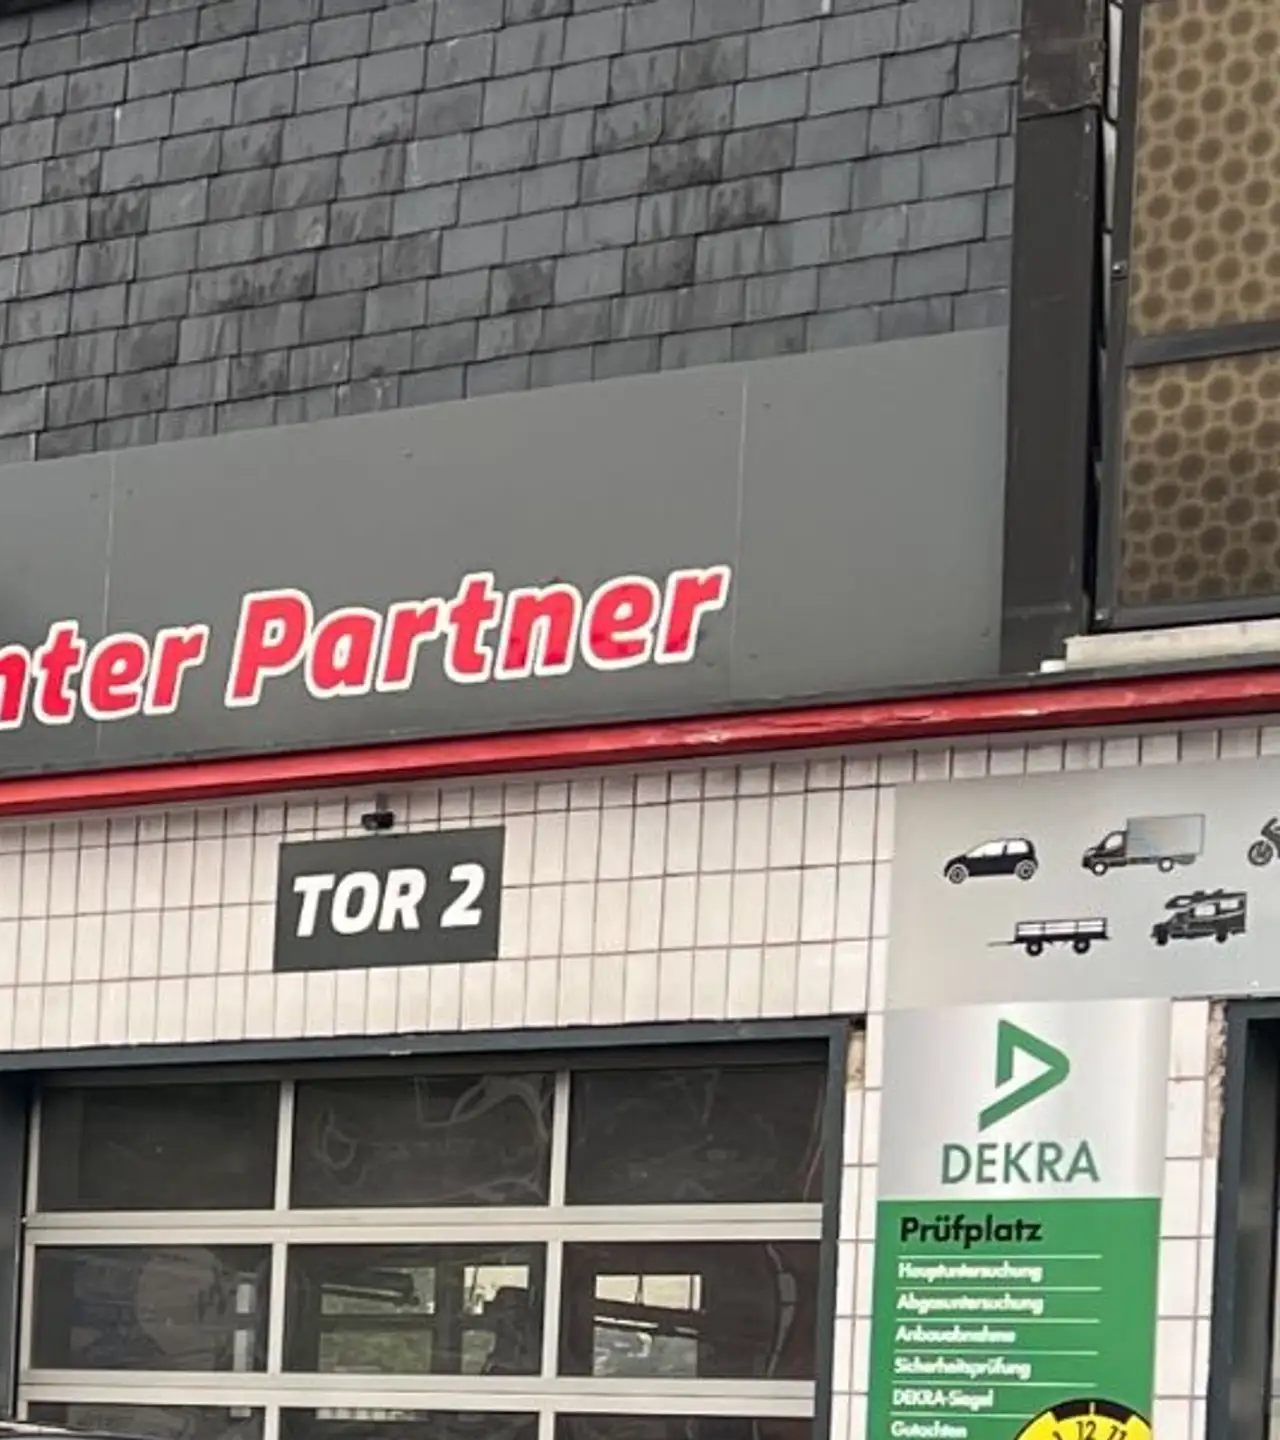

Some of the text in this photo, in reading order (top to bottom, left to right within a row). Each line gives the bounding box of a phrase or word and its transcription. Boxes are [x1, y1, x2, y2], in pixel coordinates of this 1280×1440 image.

[226, 564, 732, 706] Partner
[292, 863, 486, 937] TOR 2
[941, 1141, 1100, 1184] DEKRA
[899, 1214, 1044, 1249] Prüfplatz
